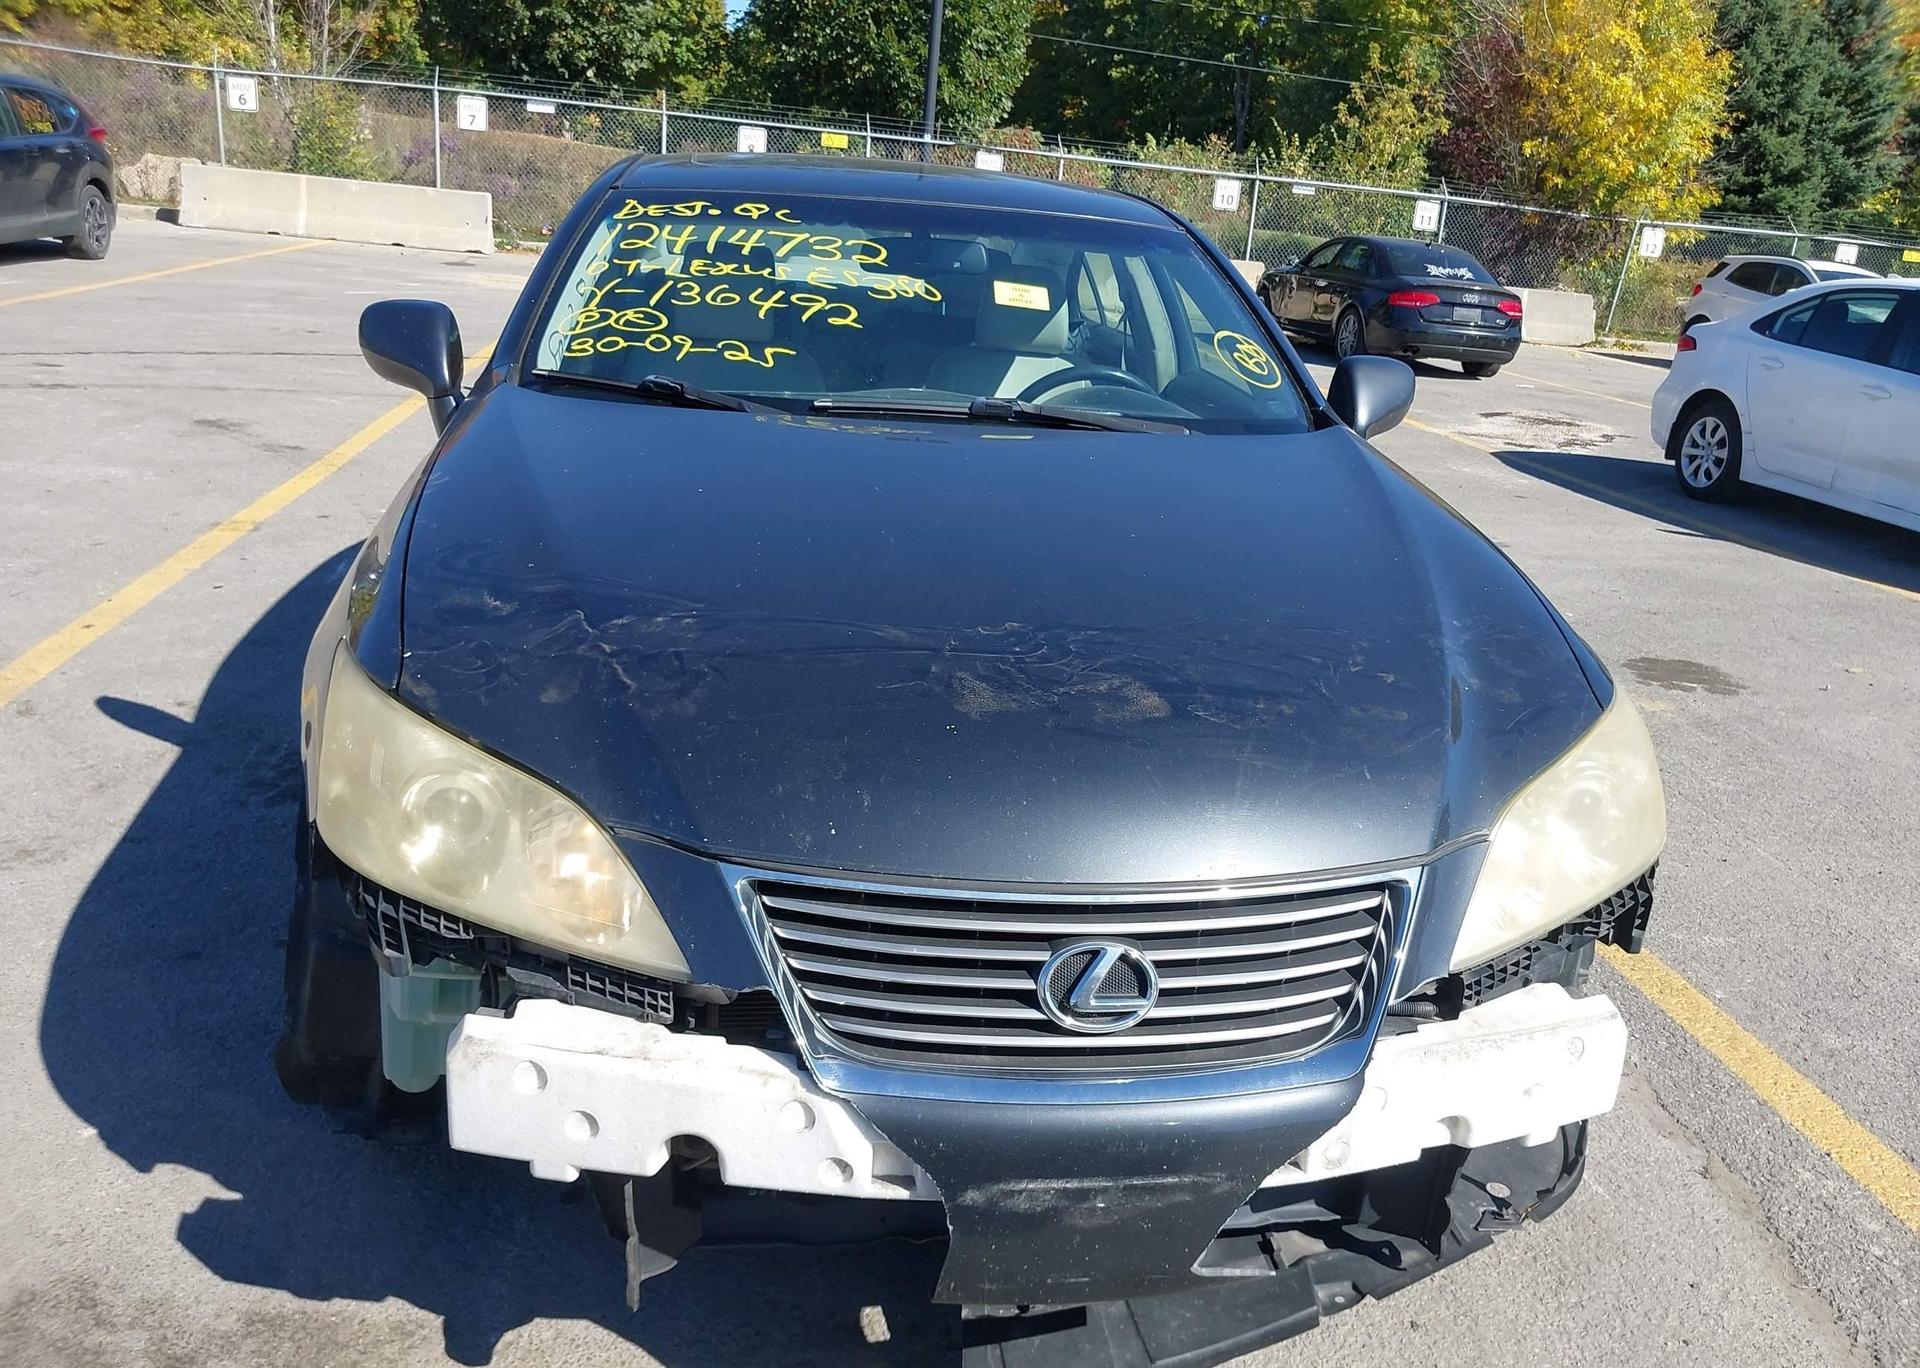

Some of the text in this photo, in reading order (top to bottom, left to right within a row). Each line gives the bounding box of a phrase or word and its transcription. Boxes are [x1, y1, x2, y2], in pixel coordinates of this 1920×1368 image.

[238, 94, 247, 105] 6
[467, 114, 476, 125] 7
[1220, 194, 1234, 205] 10
[1420, 215, 1432, 226] 11
[597, 221, 889, 267] 12414732
[1645, 243, 1657, 254] 12
[563, 333, 797, 367] 30-09-25
